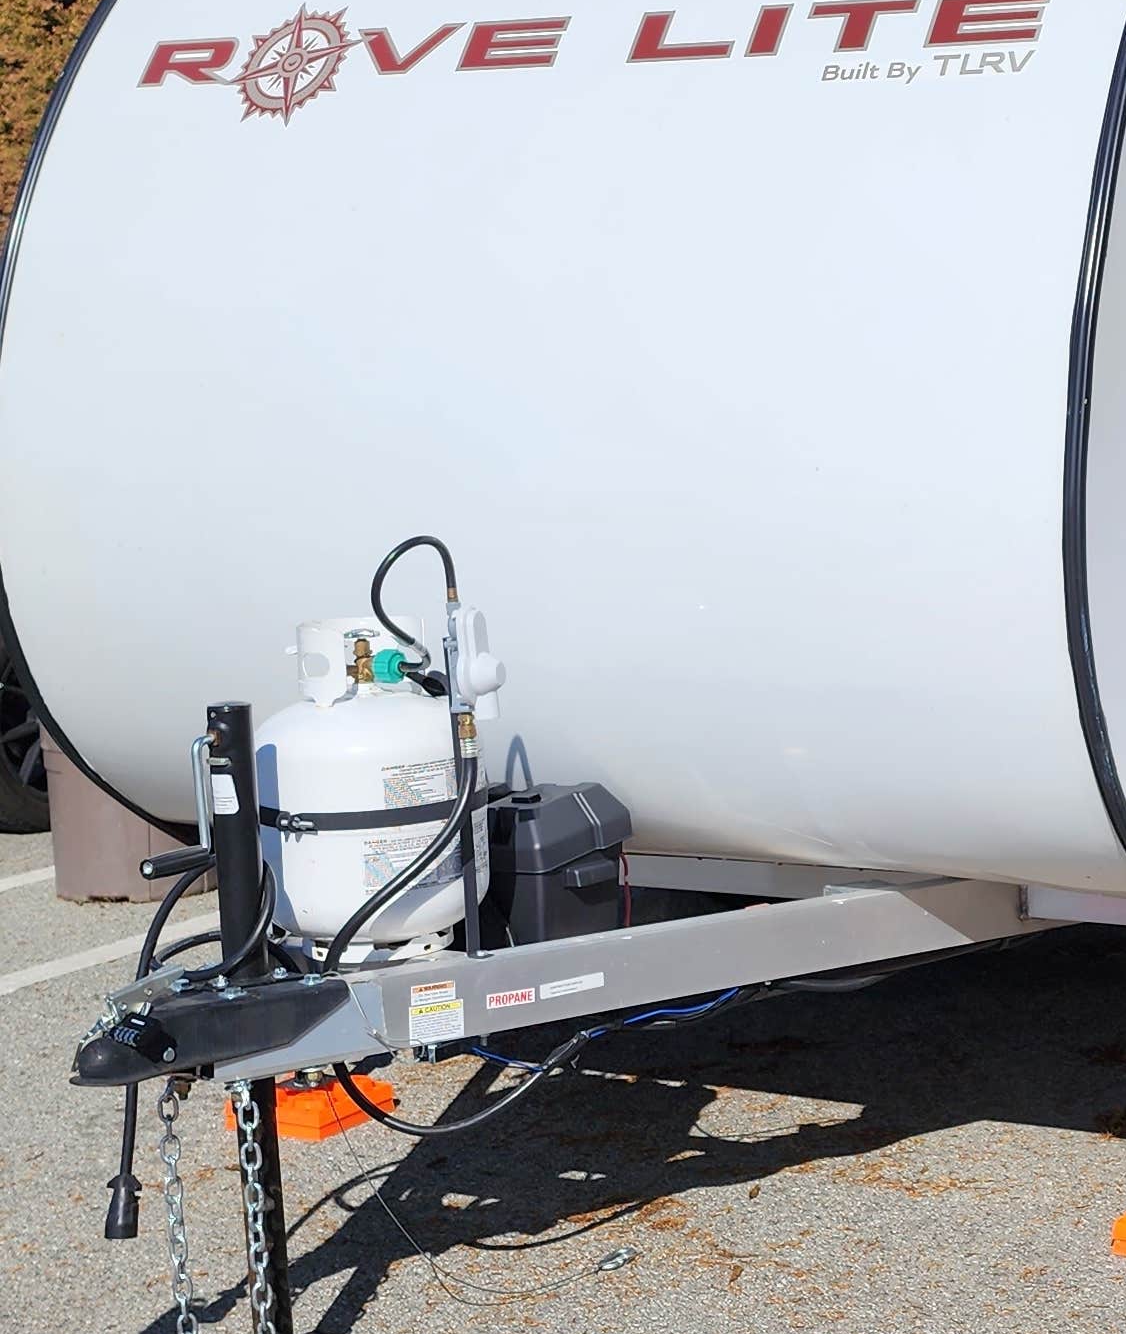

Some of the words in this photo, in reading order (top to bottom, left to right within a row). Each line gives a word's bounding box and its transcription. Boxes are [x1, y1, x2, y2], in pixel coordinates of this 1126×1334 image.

[136, 3, 572, 127] ROVE
[821, 61, 880, 82] Built
[886, 61, 923, 85] By
[933, 49, 1037, 77] TLRV
[424, 1003, 451, 1013] CAUTION
[488, 990, 533, 1007] PROPANE
